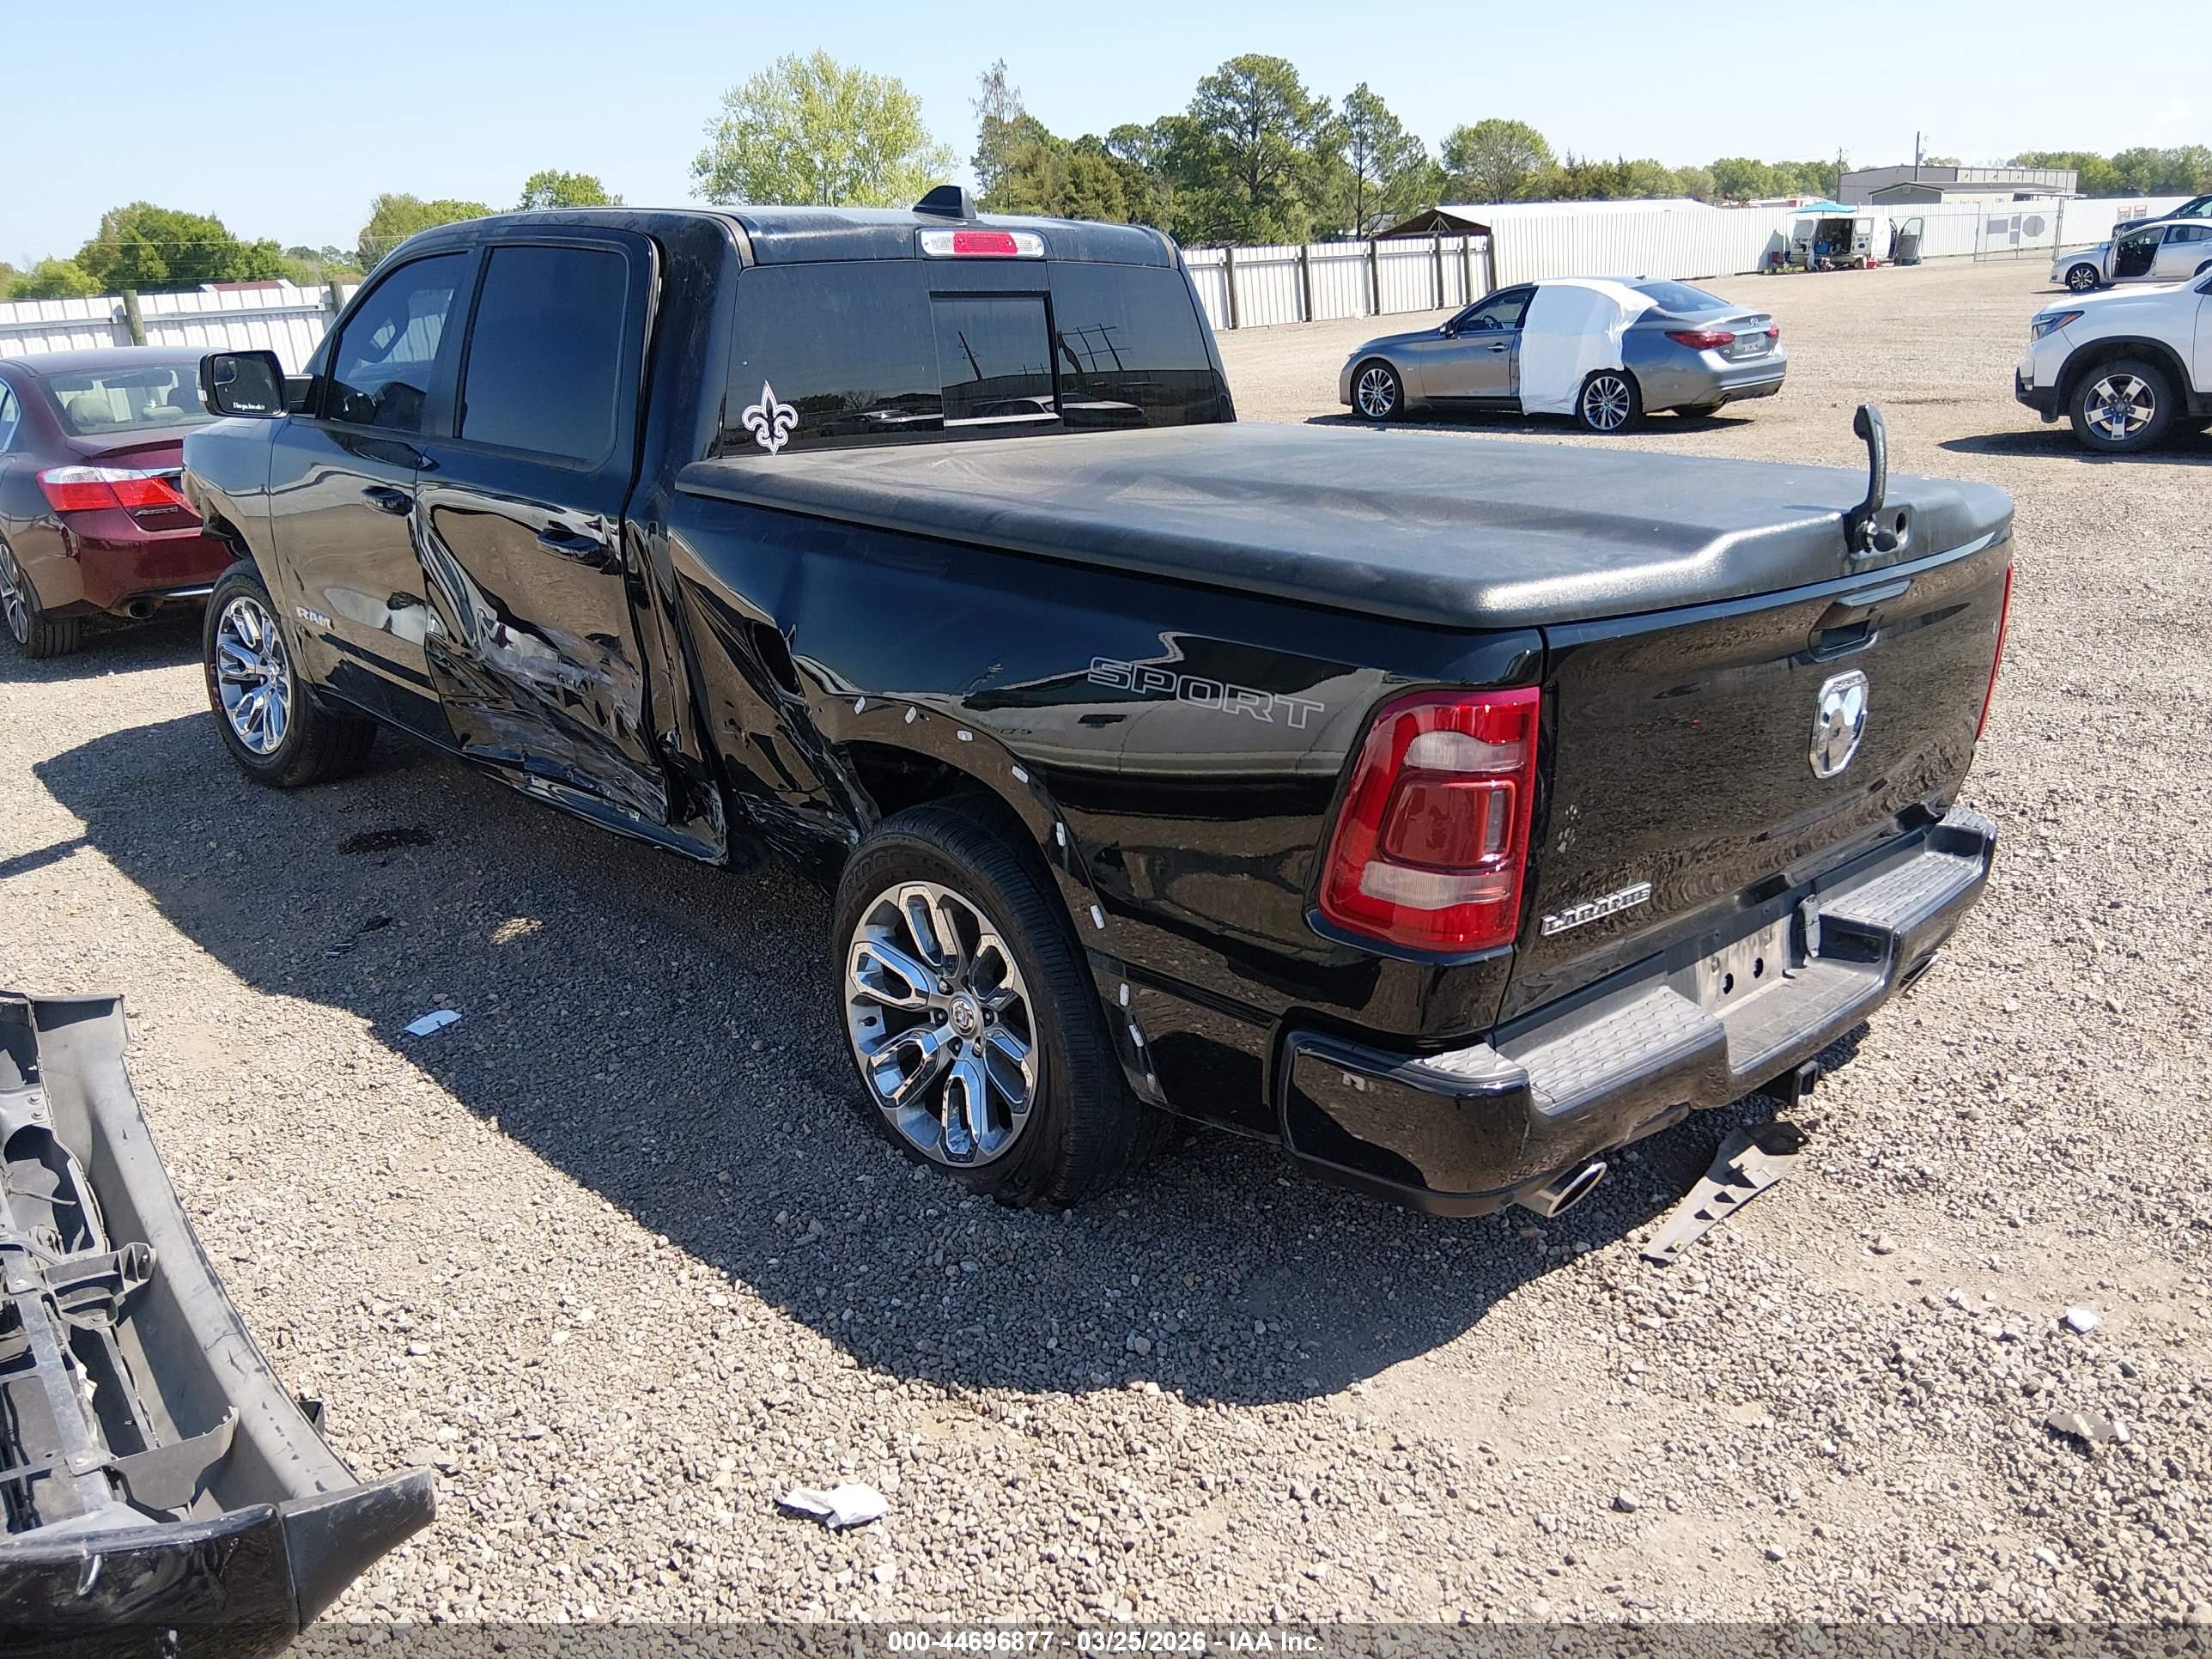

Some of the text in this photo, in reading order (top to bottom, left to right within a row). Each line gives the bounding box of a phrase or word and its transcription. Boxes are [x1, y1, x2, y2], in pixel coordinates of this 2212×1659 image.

[295, 605, 334, 630] RAM
[1087, 656, 1325, 730] SPORT
[1540, 881, 1652, 936] LARAMIE
